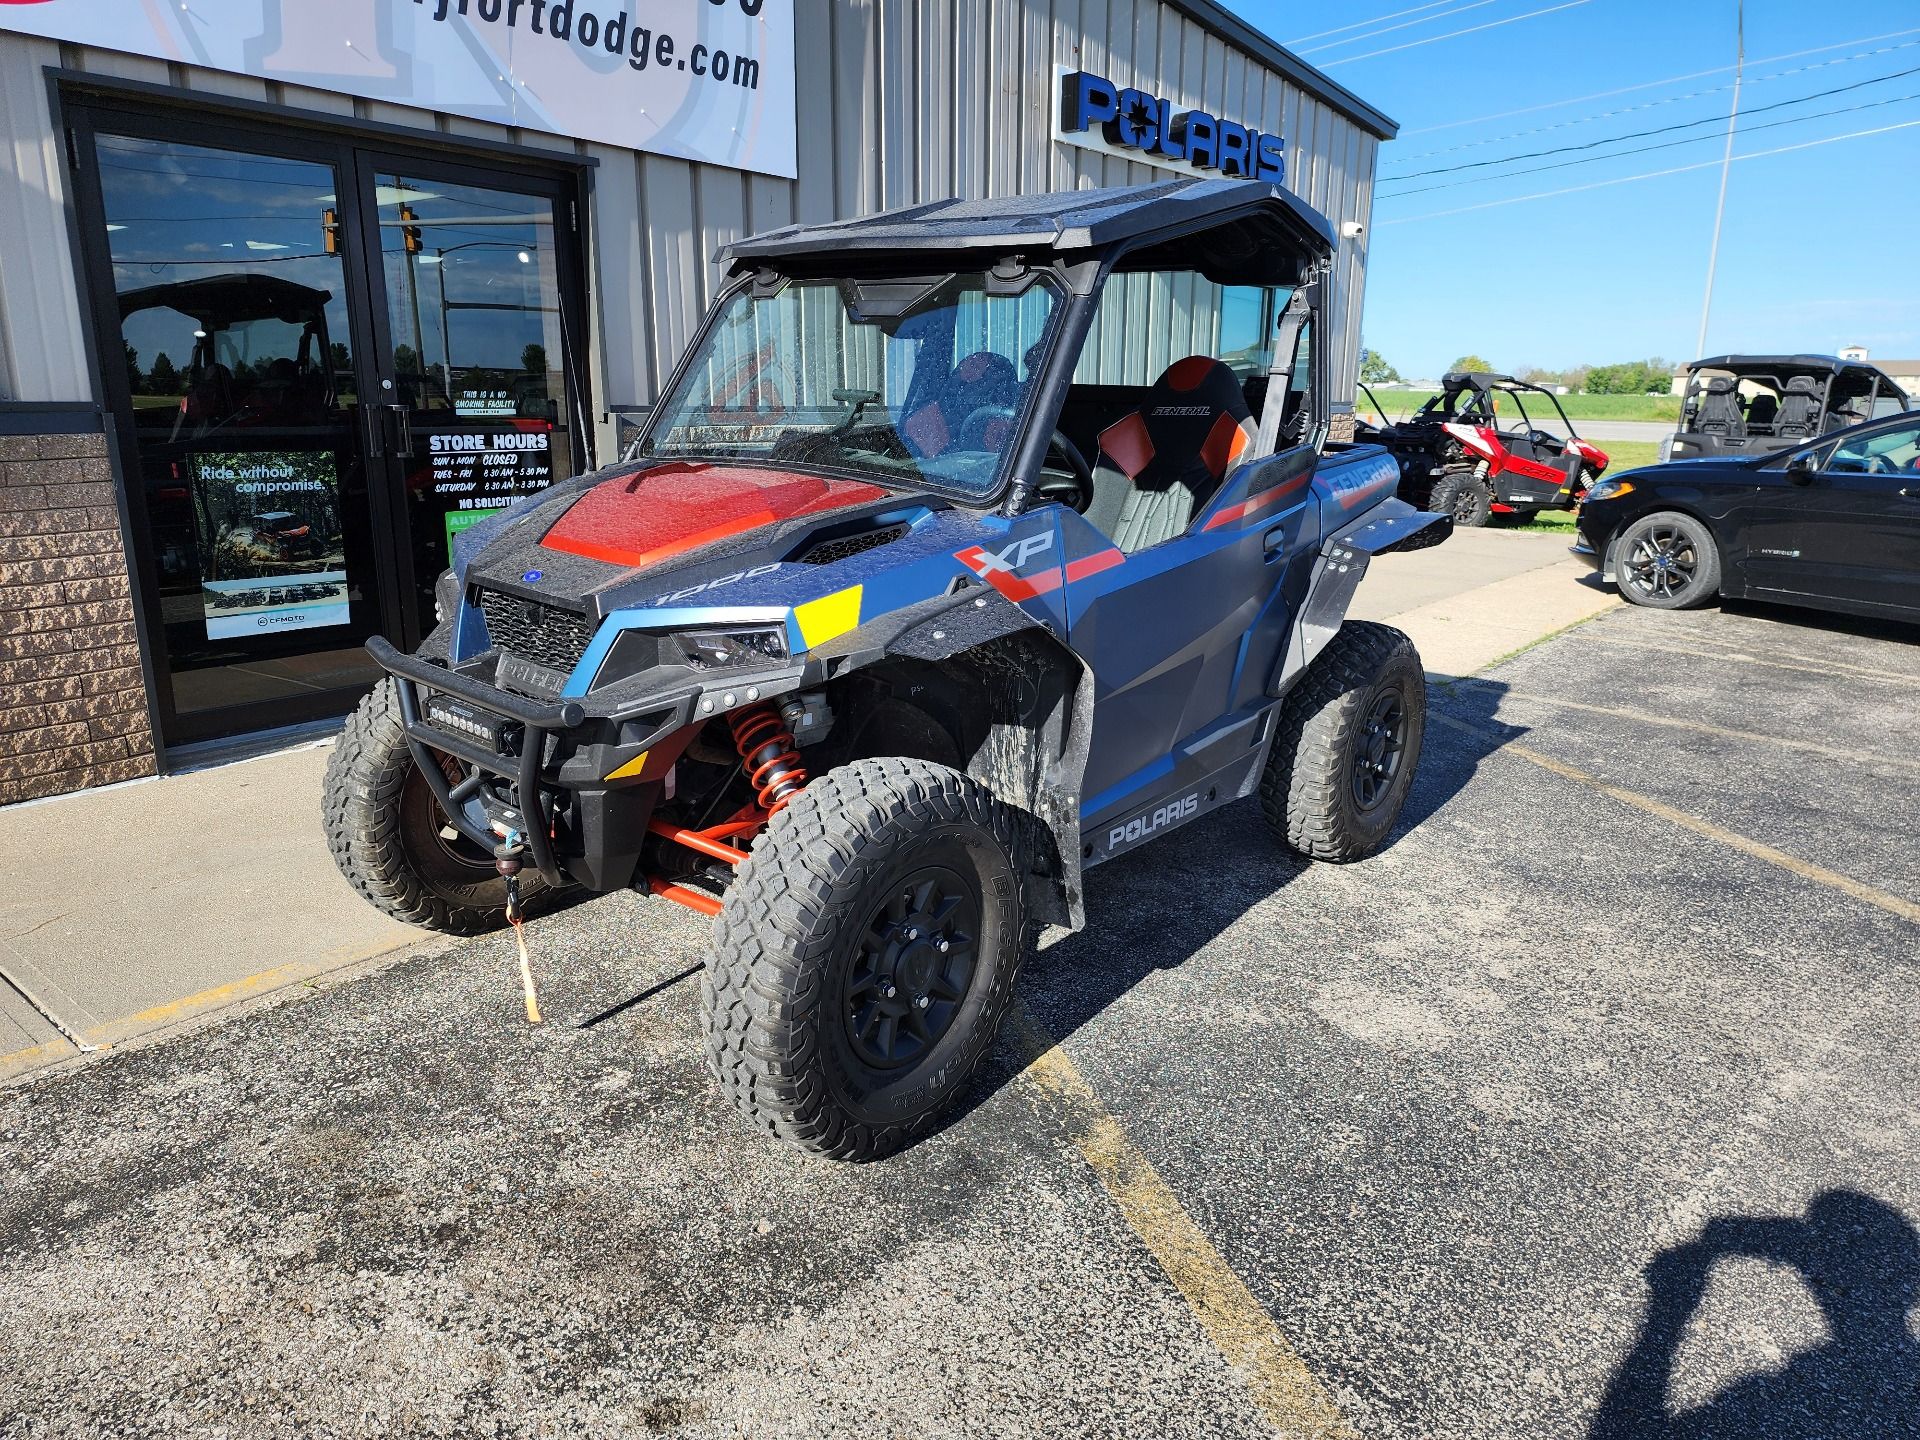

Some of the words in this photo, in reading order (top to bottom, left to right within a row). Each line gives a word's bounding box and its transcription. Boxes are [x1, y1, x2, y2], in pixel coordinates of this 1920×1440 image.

[1061, 71, 1285, 185] POLARIS
[463, 390, 477, 399] THIS
[480, 390, 487, 399] IS
[490, 390, 495, 399] A
[497, 390, 507, 399] NO
[455, 400, 485, 408] SMOKING
[488, 400, 516, 408] FACILITY
[1151, 406, 1211, 416] GENERAL
[429, 434, 486, 451] STORE
[493, 433, 548, 450] HOURS
[432, 456, 450, 466] SUN
[456, 456, 477, 465] MON
[482, 453, 518, 465] CLOSED
[201, 466, 235, 480] Ride
[239, 464, 293, 479] without
[433, 470, 453, 479] TUES
[459, 469, 473, 478] FRI
[499, 468, 514, 477] AM
[535, 466, 549, 475] PM
[235, 479, 326, 495] compromise.
[434, 482, 477, 493] SATURDAY
[501, 481, 515, 489] AM
[536, 479, 550, 488] PM
[459, 498, 473, 509] NO
[974, 529, 1055, 579] XP
[1761, 548, 1793, 556] HYBRID
[269, 615, 305, 624] CFMOTO
[1108, 792, 1198, 851] POLARIS
